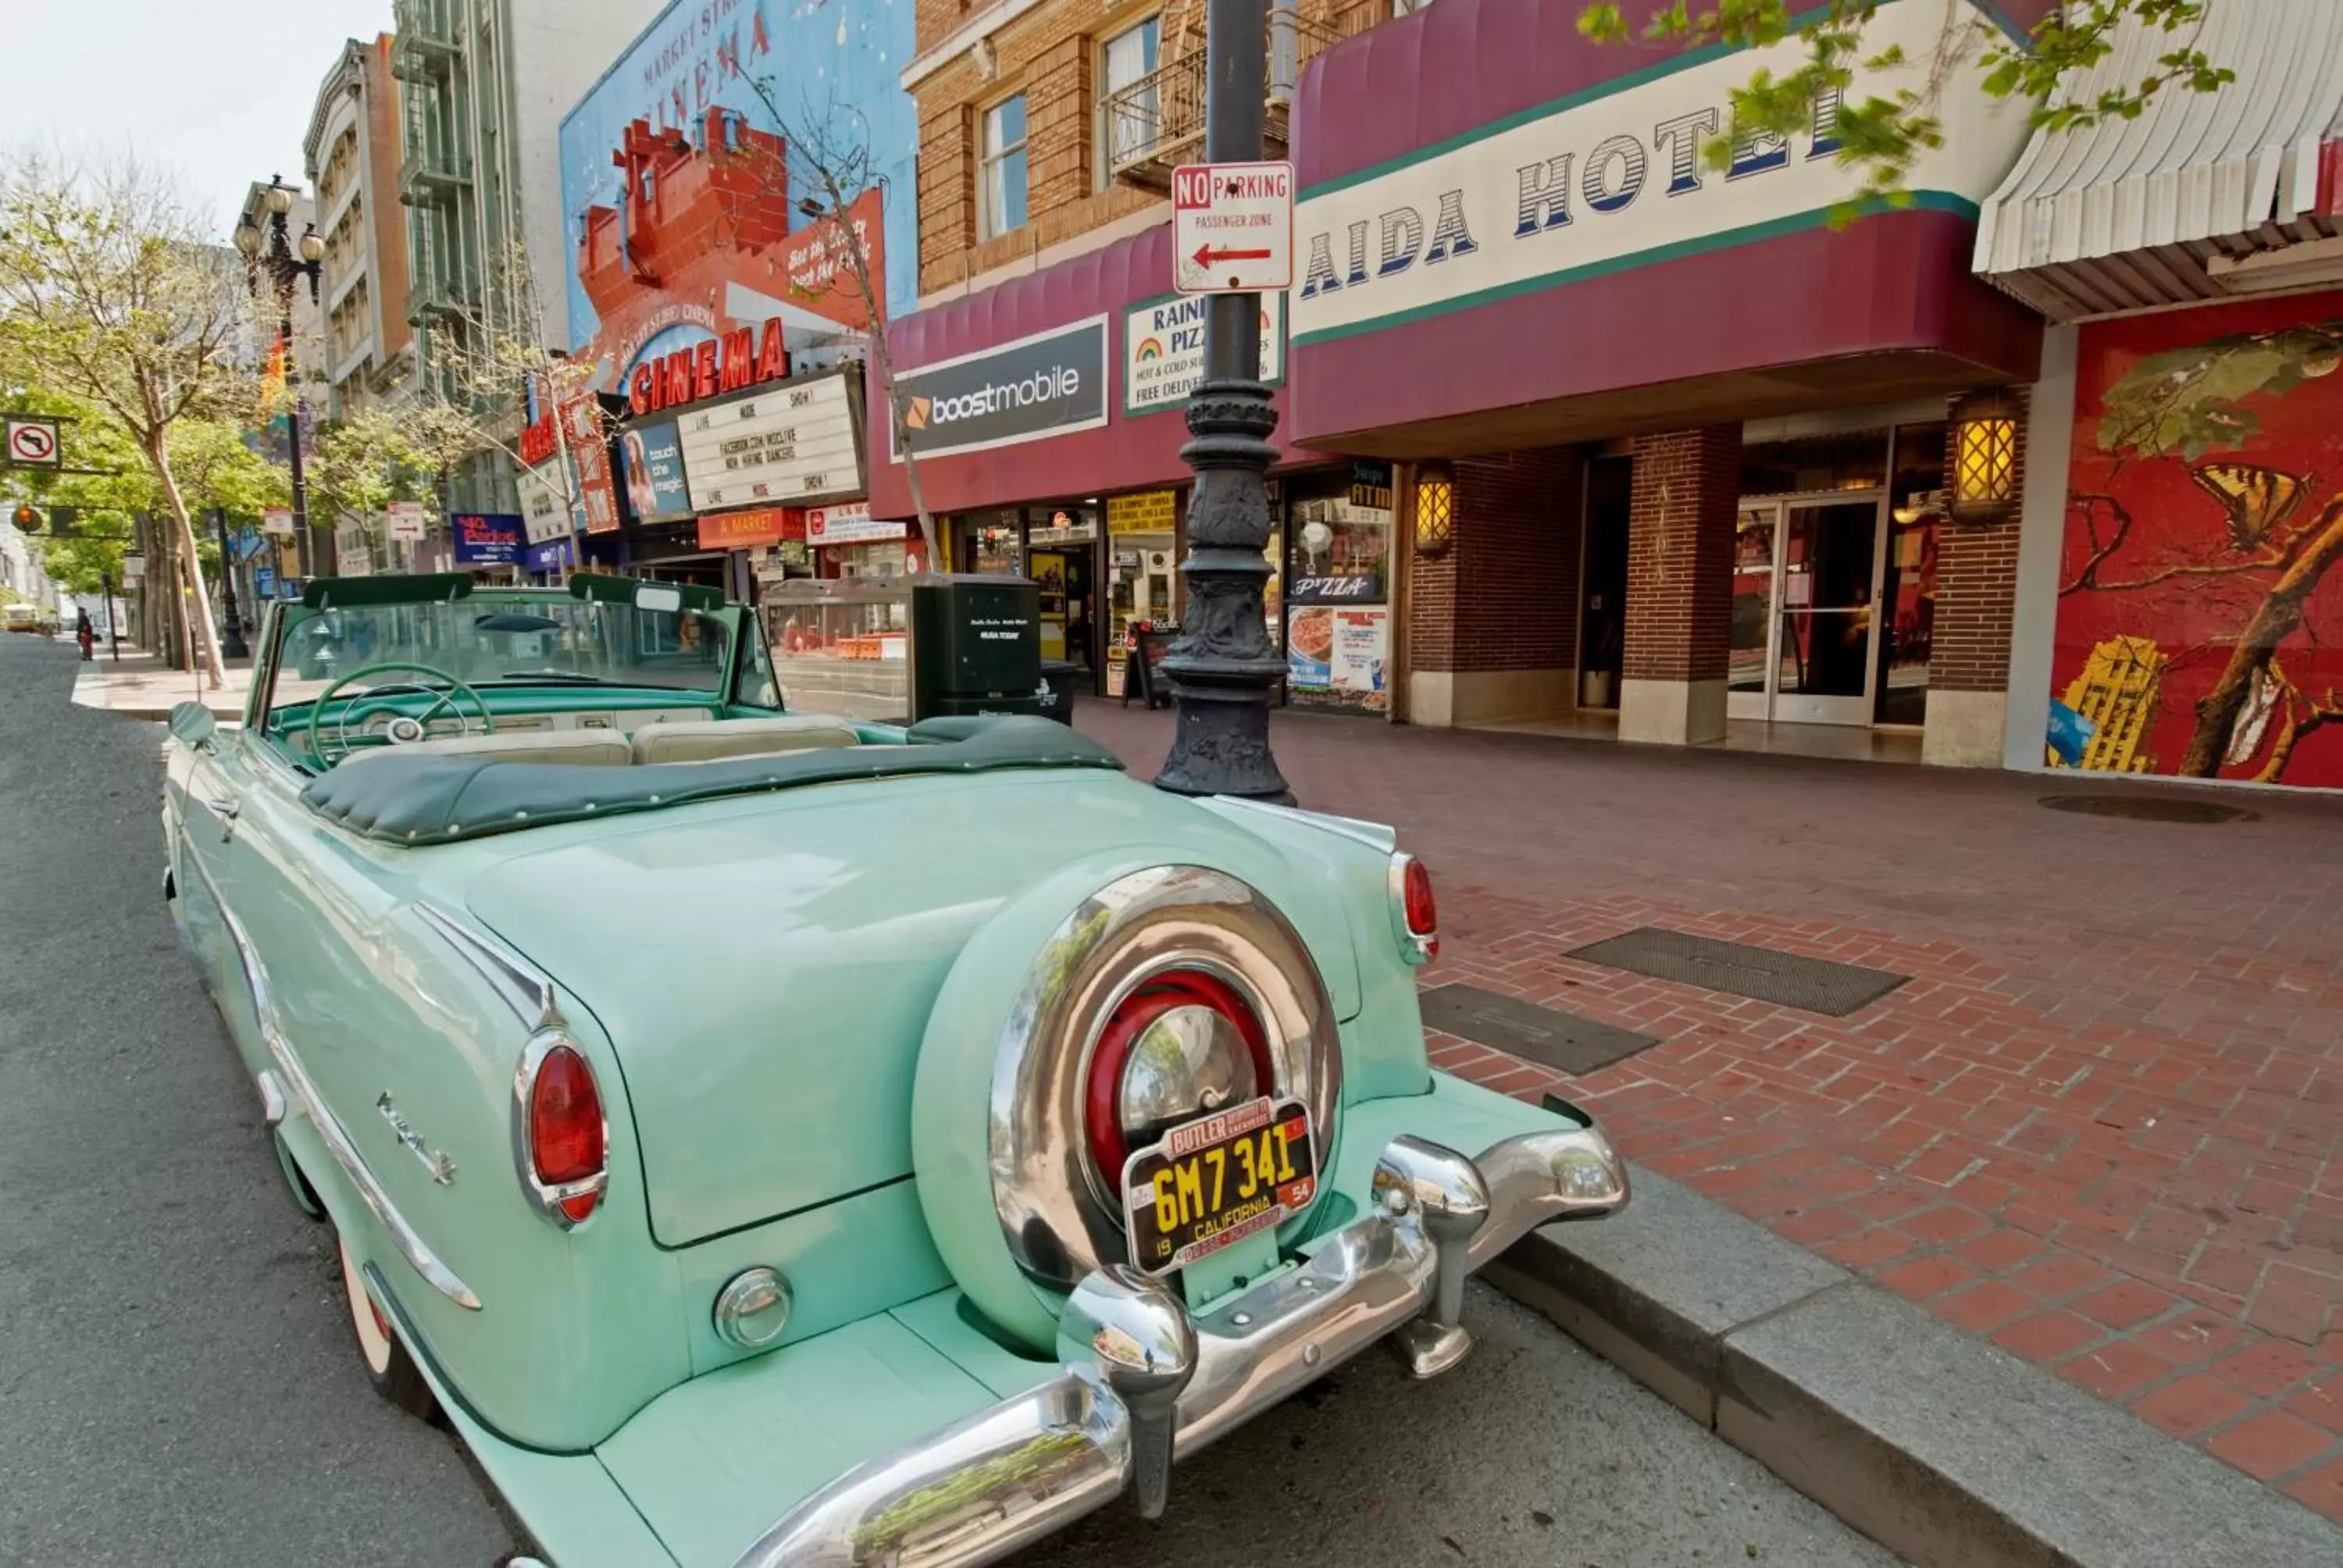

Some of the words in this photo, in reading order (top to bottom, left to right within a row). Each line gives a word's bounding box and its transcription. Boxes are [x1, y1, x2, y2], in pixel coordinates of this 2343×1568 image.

[644, 20, 695, 87] MARKET
[642, 8, 771, 129] INEMA
[1177, 172, 1208, 205] NO
[1214, 173, 1286, 200] PARKING
[1195, 214, 1247, 230] PASSENGER
[1249, 213, 1272, 227] ZONE
[1299, 187, 1479, 301] AIDA
[631, 316, 788, 416] CINEMA
[1136, 367, 1154, 381] HOT
[1155, 365, 1161, 377] &
[1164, 361, 1188, 375] COLD
[1136, 386, 1160, 403] FREE
[1163, 376, 1203, 397] DELIVE
[649, 443, 677, 461] touch
[652, 463, 670, 477] the
[654, 476, 684, 494] magic
[732, 512, 773, 534] MARKET
[1173, 1114, 1227, 1153] BUTLER
[1152, 1147, 1225, 1234] 6M7
[1233, 1124, 1296, 1199] 341
[1292, 1184, 1310, 1201] 54
[1194, 1196, 1271, 1241] CALIFORNIA
[1157, 1238, 1172, 1258] 19
